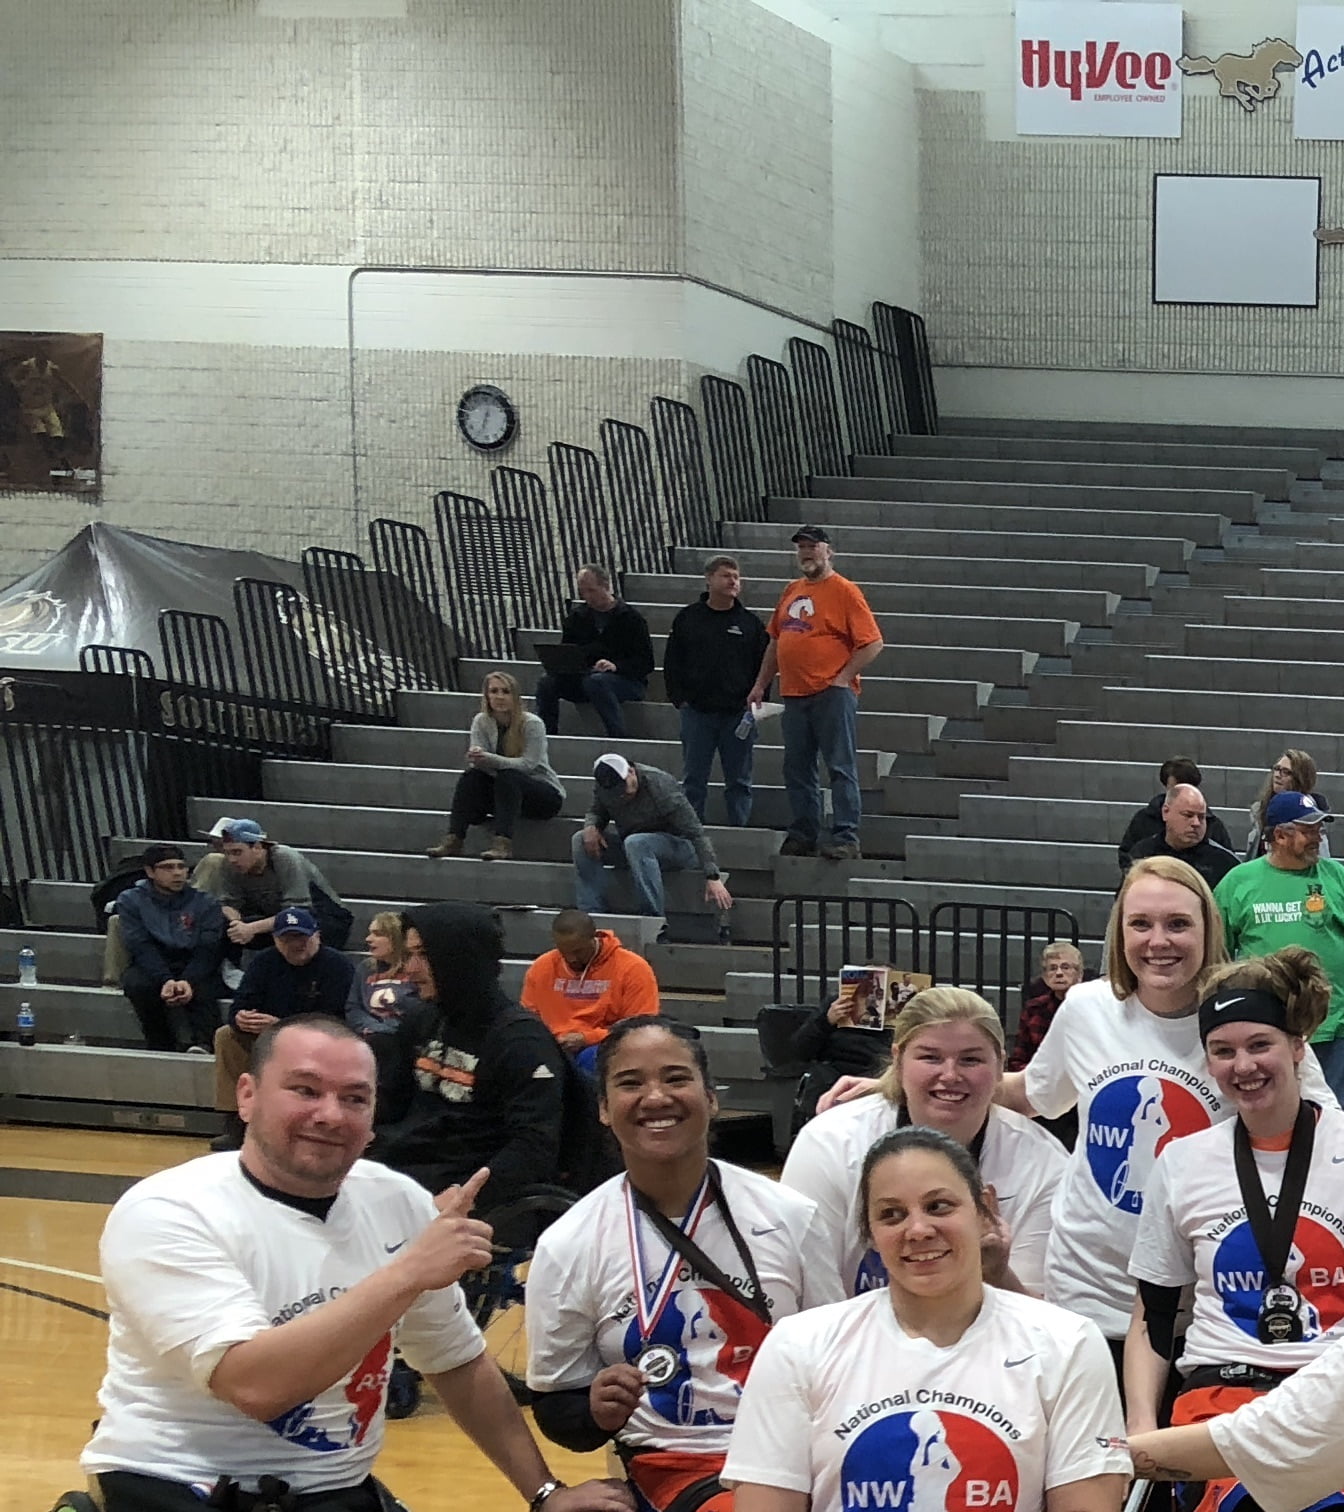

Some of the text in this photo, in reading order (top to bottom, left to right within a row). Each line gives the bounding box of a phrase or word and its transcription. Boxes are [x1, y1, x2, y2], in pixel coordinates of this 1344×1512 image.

[1094, 94, 1166, 103] EMPLOYEE OWNED
[1253, 900, 1302, 914] WANNA GET
[1275, 911, 1303, 923] LUCKY?
[1088, 1058, 1222, 1113] National Champions
[1089, 1125, 1130, 1149] NW
[1216, 1271, 1264, 1293] NW
[833, 1388, 1023, 1441] National Champions
[846, 1480, 1013, 1509] NW BA
